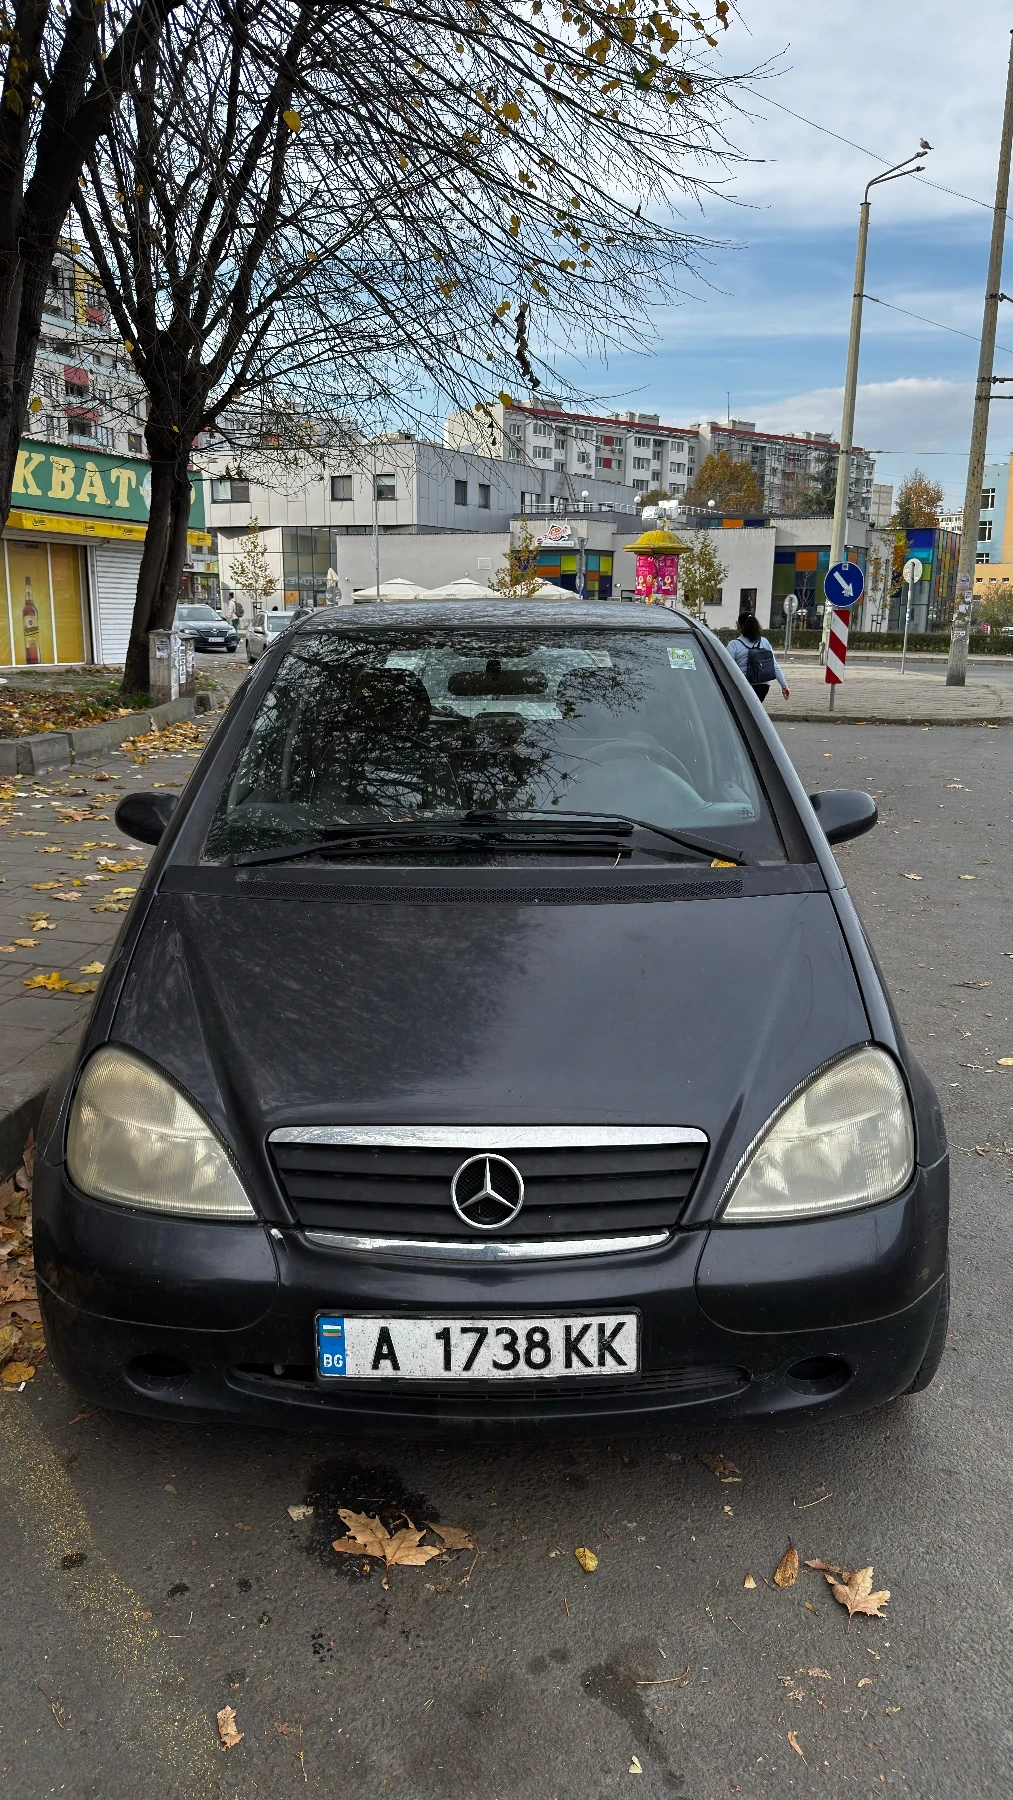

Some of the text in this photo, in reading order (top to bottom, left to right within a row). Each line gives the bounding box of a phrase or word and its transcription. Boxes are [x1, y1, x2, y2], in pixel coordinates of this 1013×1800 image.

[12, 450, 196, 508] КВАТ
[323, 1353, 343, 1368] BG
[371, 1321, 628, 1371] A 1738 KK
